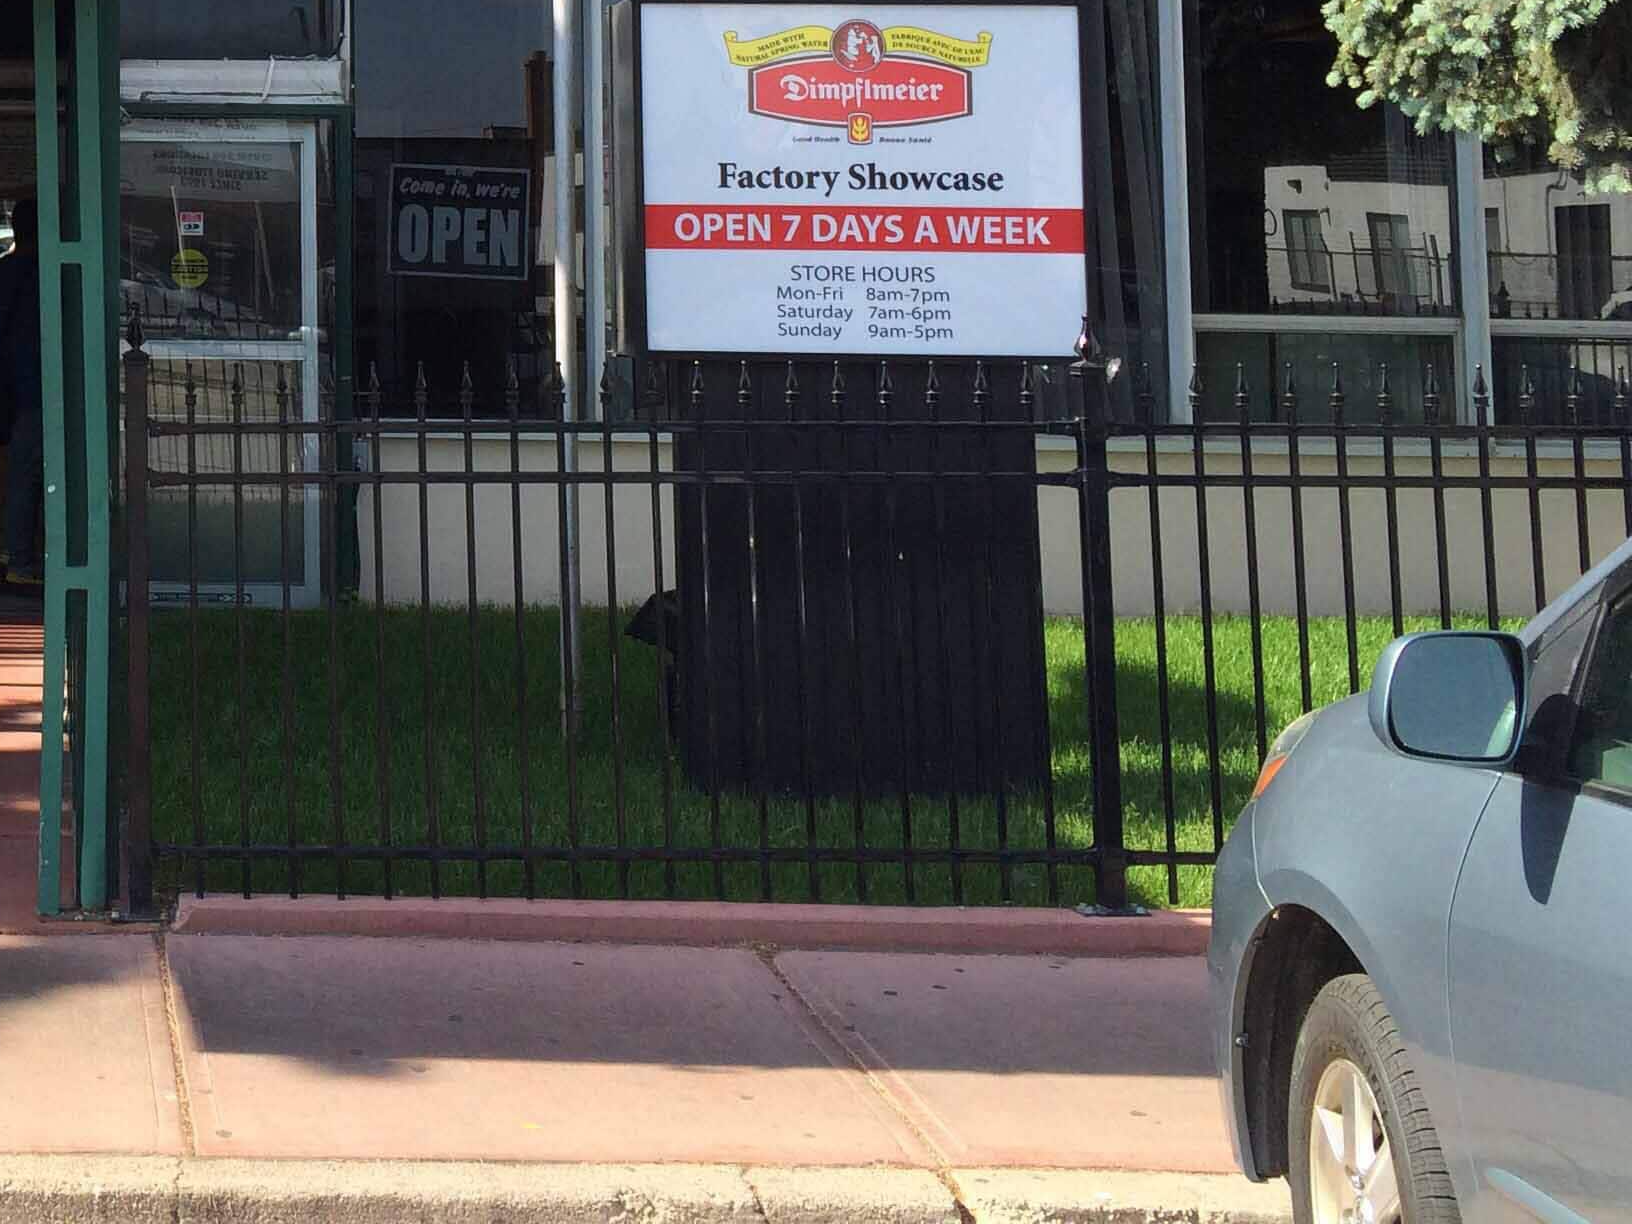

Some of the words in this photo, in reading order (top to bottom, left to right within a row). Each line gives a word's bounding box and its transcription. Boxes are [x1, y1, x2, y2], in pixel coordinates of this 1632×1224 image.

[779, 74, 944, 108] Dimpflmeier
[399, 176, 445, 196] Come
[717, 162, 840, 197] Factory
[848, 163, 1005, 192] Showcase
[398, 203, 520, 267] OPEN
[674, 213, 772, 242] OPEN
[782, 215, 801, 242] 7
[812, 214, 904, 244] DAYS
[913, 215, 938, 243] A
[946, 216, 1050, 245] WEEK
[791, 265, 856, 282] STORE
[862, 266, 936, 283] HOURS
[777, 286, 843, 301] Mon-Fri
[866, 287, 950, 303] 8am-7pm
[777, 304, 853, 322] Saturday
[868, 306, 951, 322] 7am-6pm
[777, 322, 843, 340] Sunday
[868, 324, 953, 340] 9am-5pm
